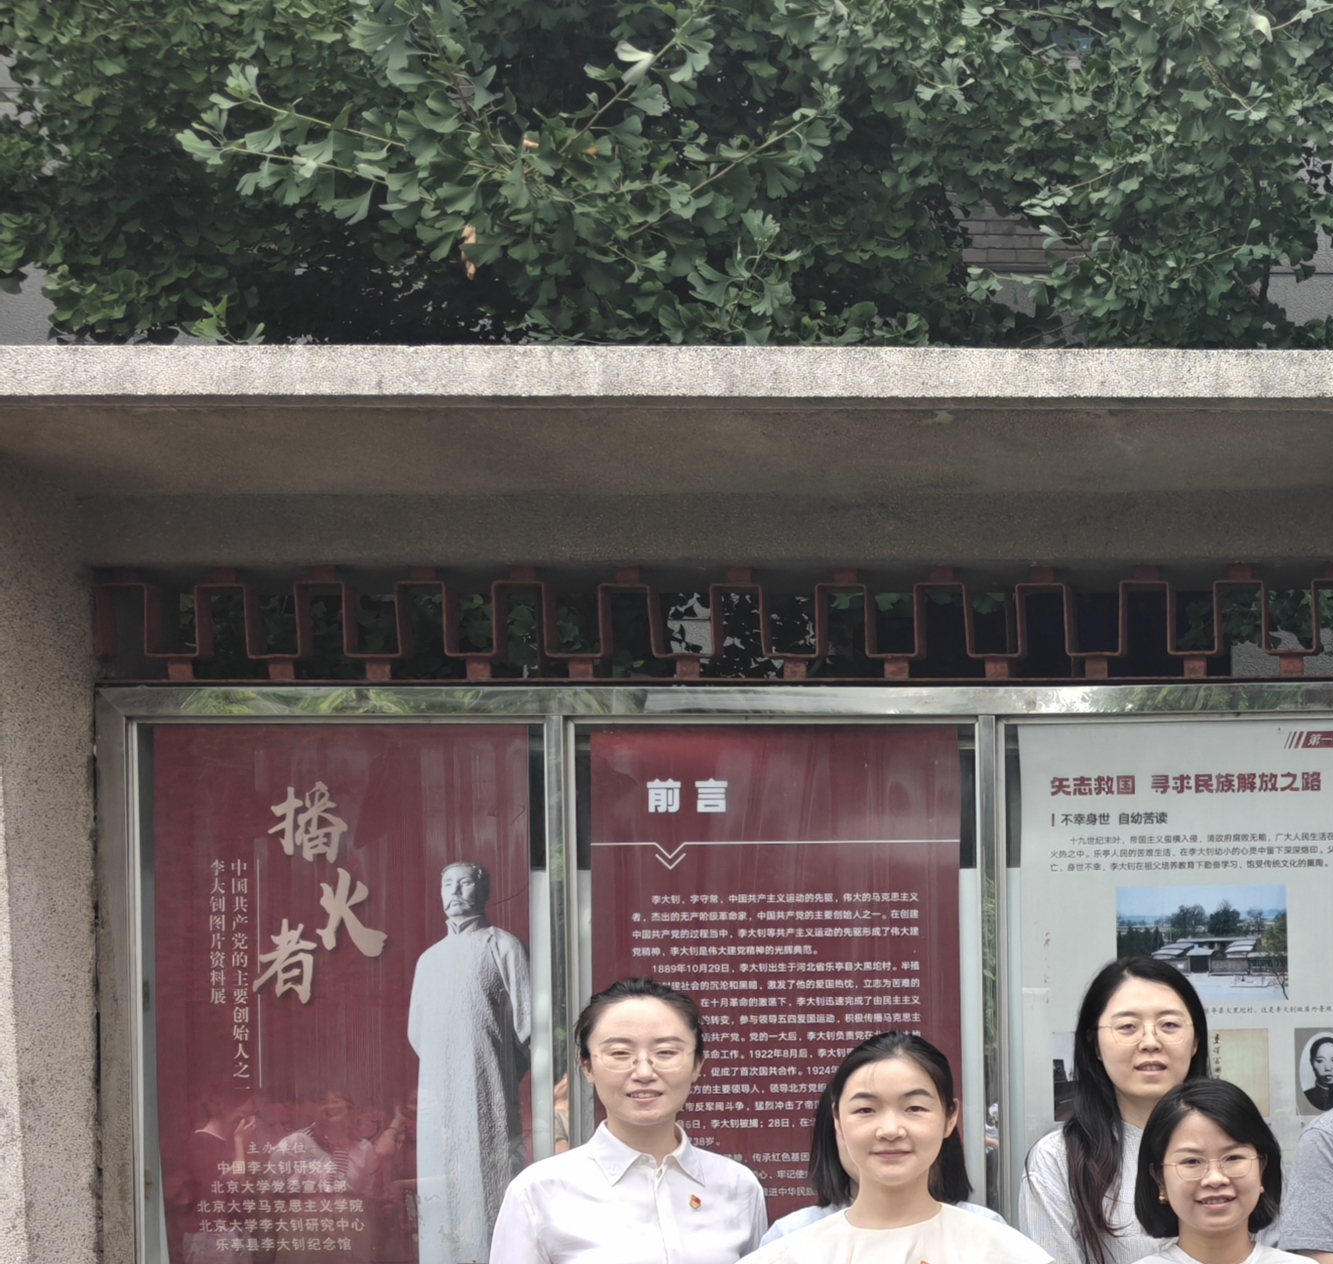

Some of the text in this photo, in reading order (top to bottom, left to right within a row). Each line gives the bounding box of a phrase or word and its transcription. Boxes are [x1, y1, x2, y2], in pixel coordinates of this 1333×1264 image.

[1050, 772, 1321, 797] 矢志救国 寻求民族解放之路
[646, 778, 728, 813] 前言
[1061, 811, 1168, 826] 不幸身世 自幼苦读
[253, 781, 388, 1004] 播火者
[209, 859, 226, 1005] 李大钊图片资料展
[231, 859, 250, 1090] 中国共产党的主要创始人之一
[247, 1141, 307, 1154] 主办单位
[217, 1161, 338, 1175] 中国李大钊研究会
[211, 1180, 347, 1194] 北京大学党委宣传部
[197, 1200, 363, 1213] 北京大学马克思主义学院
[199, 1218, 365, 1232] 北京大学李大钊研究中心
[216, 1238, 352, 1251] 乐亭县李大钊纪念馆
